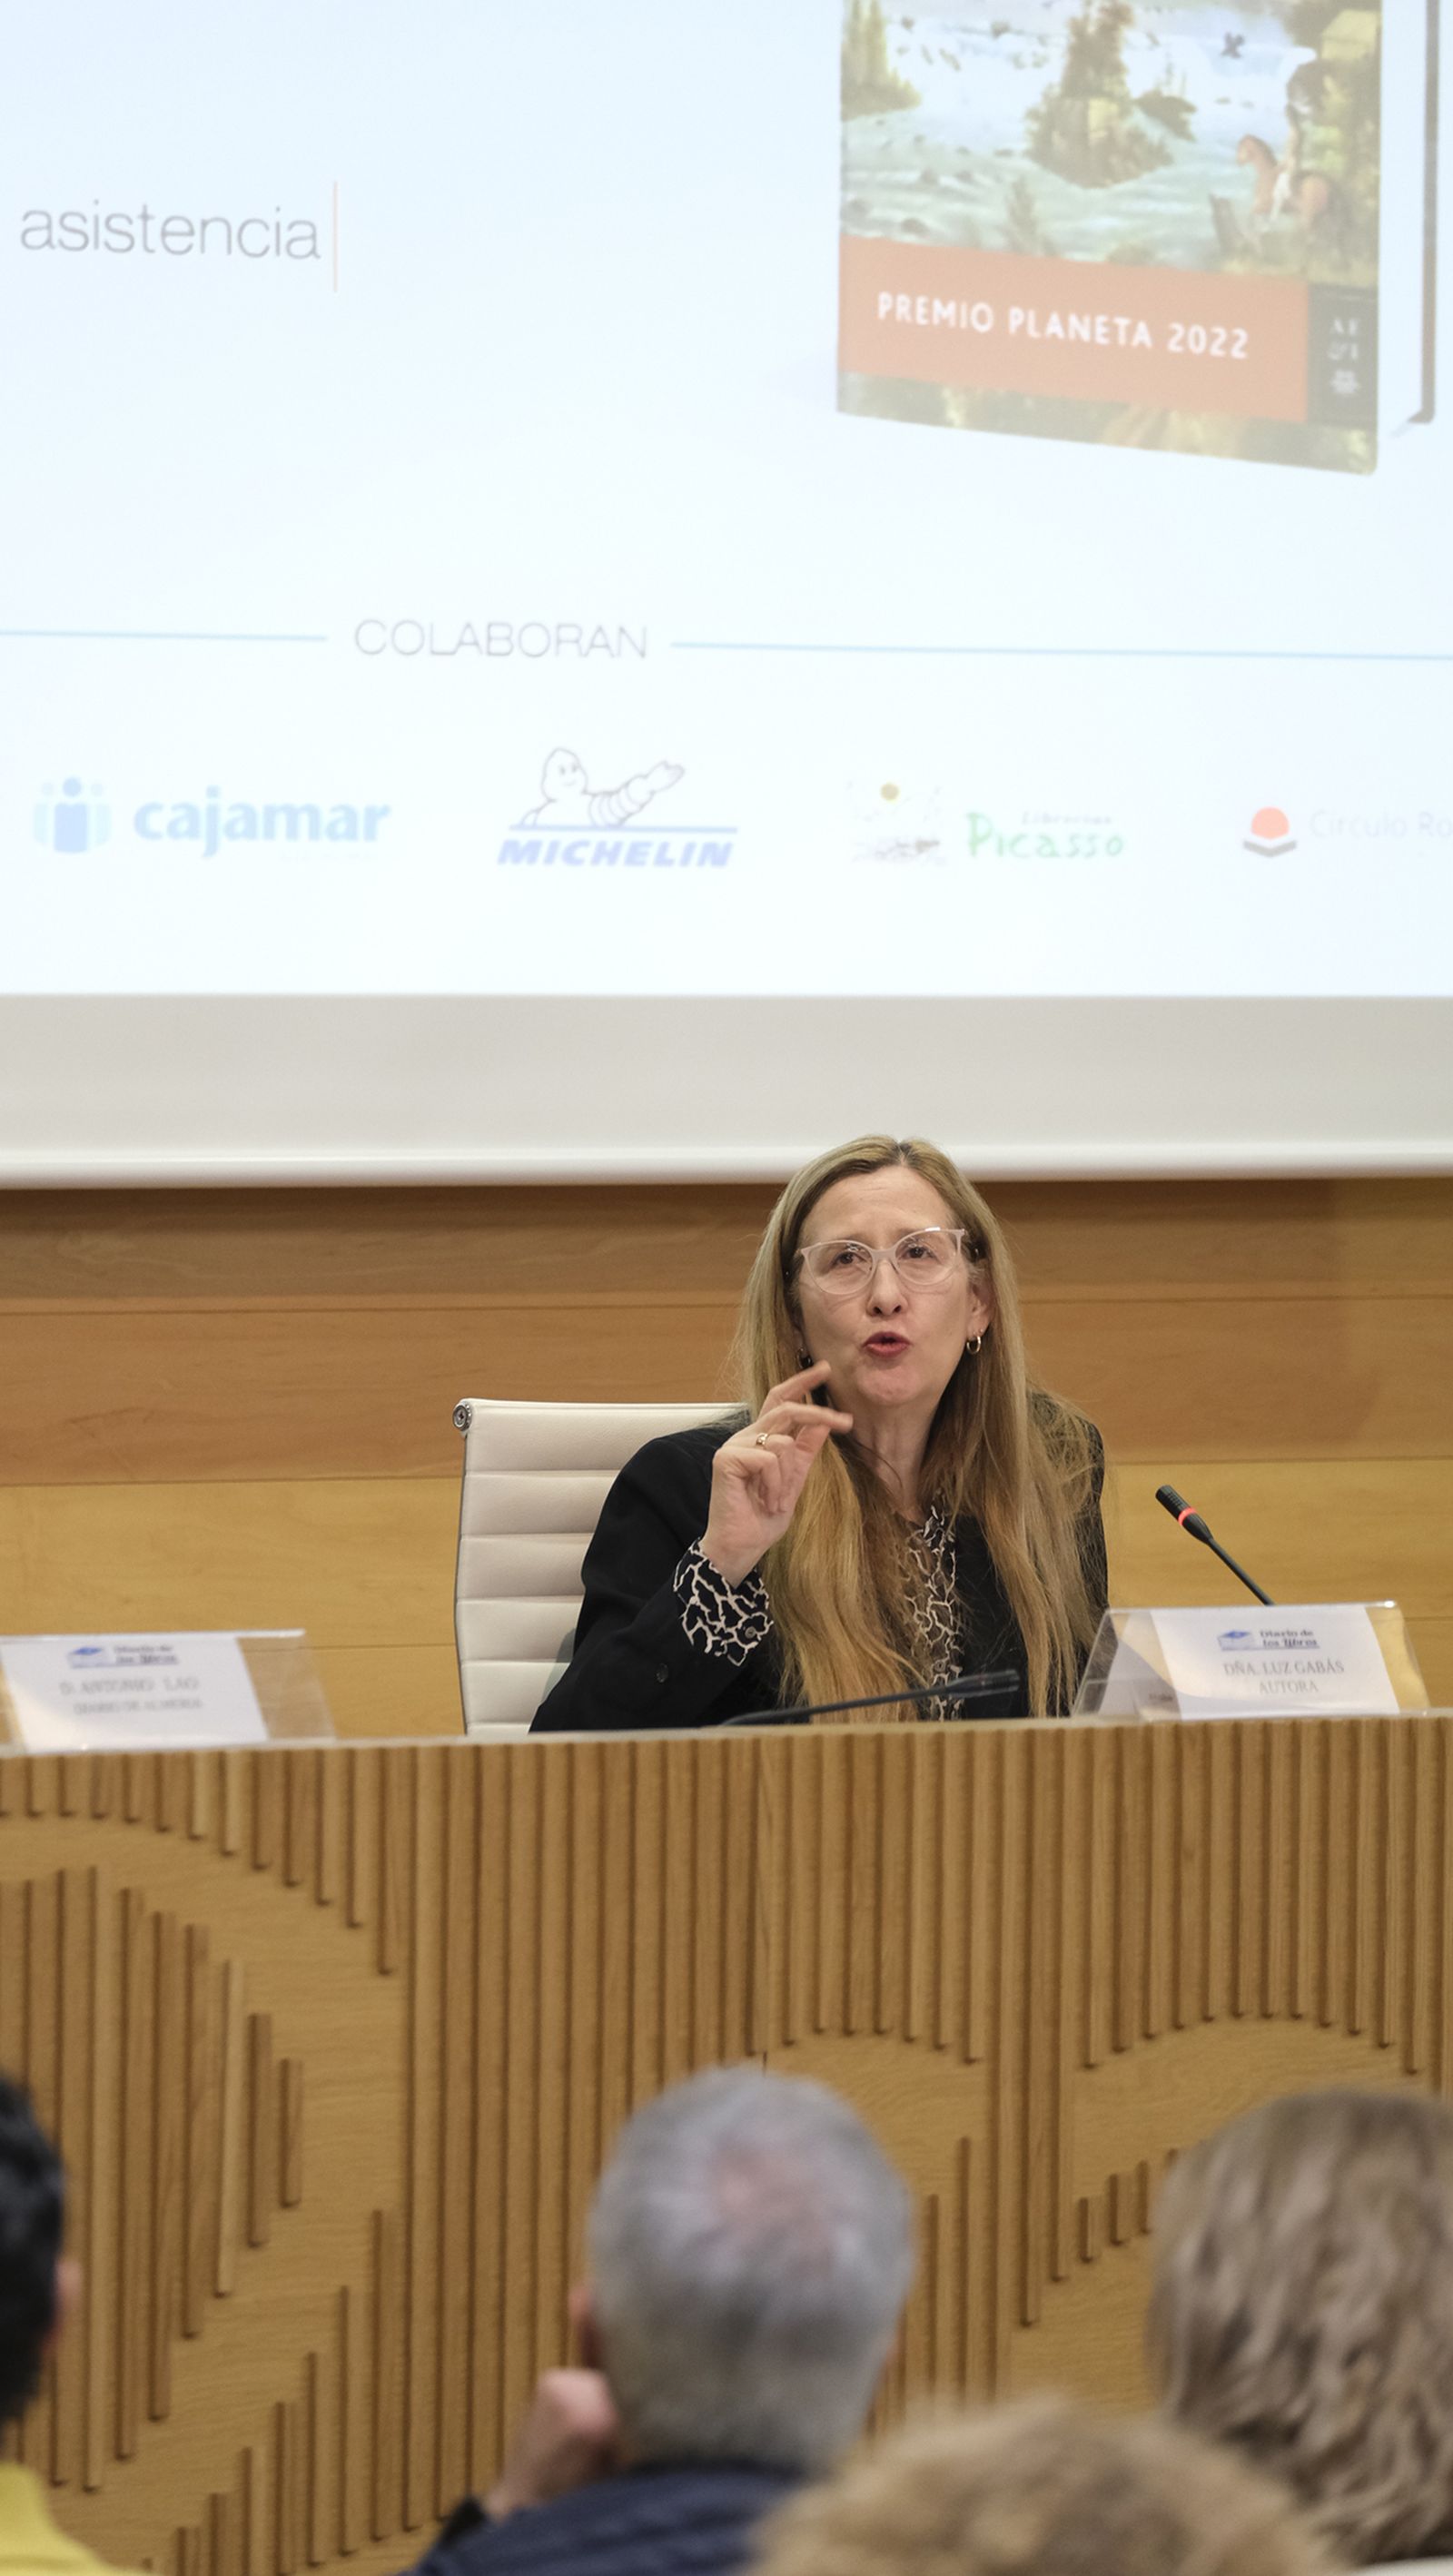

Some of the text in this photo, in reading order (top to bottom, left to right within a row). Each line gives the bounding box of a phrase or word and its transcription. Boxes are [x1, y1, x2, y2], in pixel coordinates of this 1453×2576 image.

[20, 199, 321, 261] asistencia
[876, 291, 1250, 360] PREMIO PLANETA 2022
[354, 618, 649, 658] COLABORAN
[133, 785, 392, 860] cajamar
[964, 811, 1125, 858] Picasso
[498, 838, 735, 869] MICHELIN
[1258, 1679, 1320, 1694] AUTORA
[1262, 1661, 1293, 1675] LUZ
[1294, 1656, 1345, 1675] GABÁS
